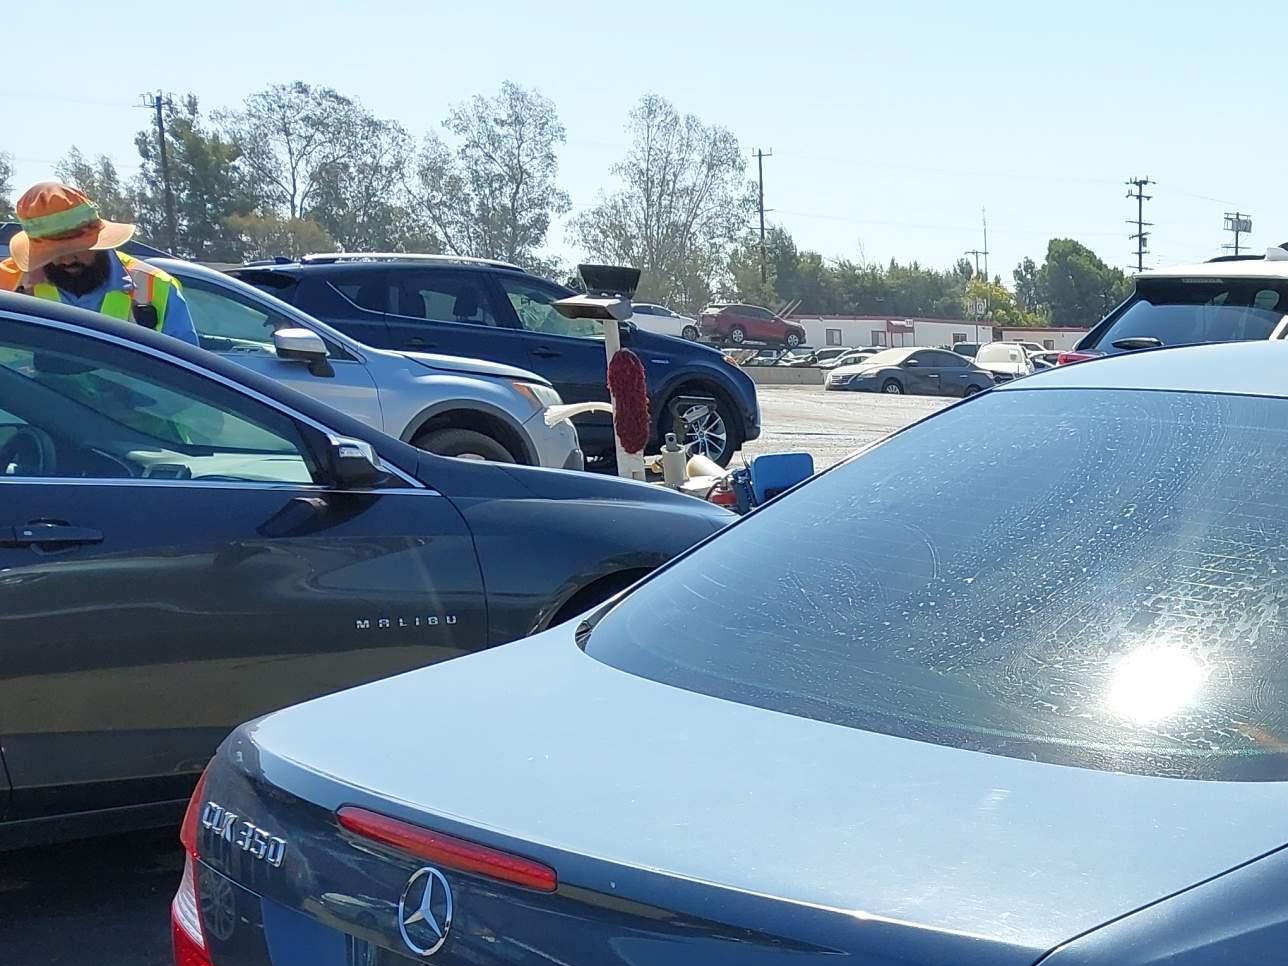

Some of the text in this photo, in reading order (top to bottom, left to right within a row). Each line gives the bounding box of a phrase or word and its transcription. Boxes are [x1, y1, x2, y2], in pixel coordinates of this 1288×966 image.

[356, 615, 457, 630] MALIBU
[202, 801, 288, 868] CLK 350
